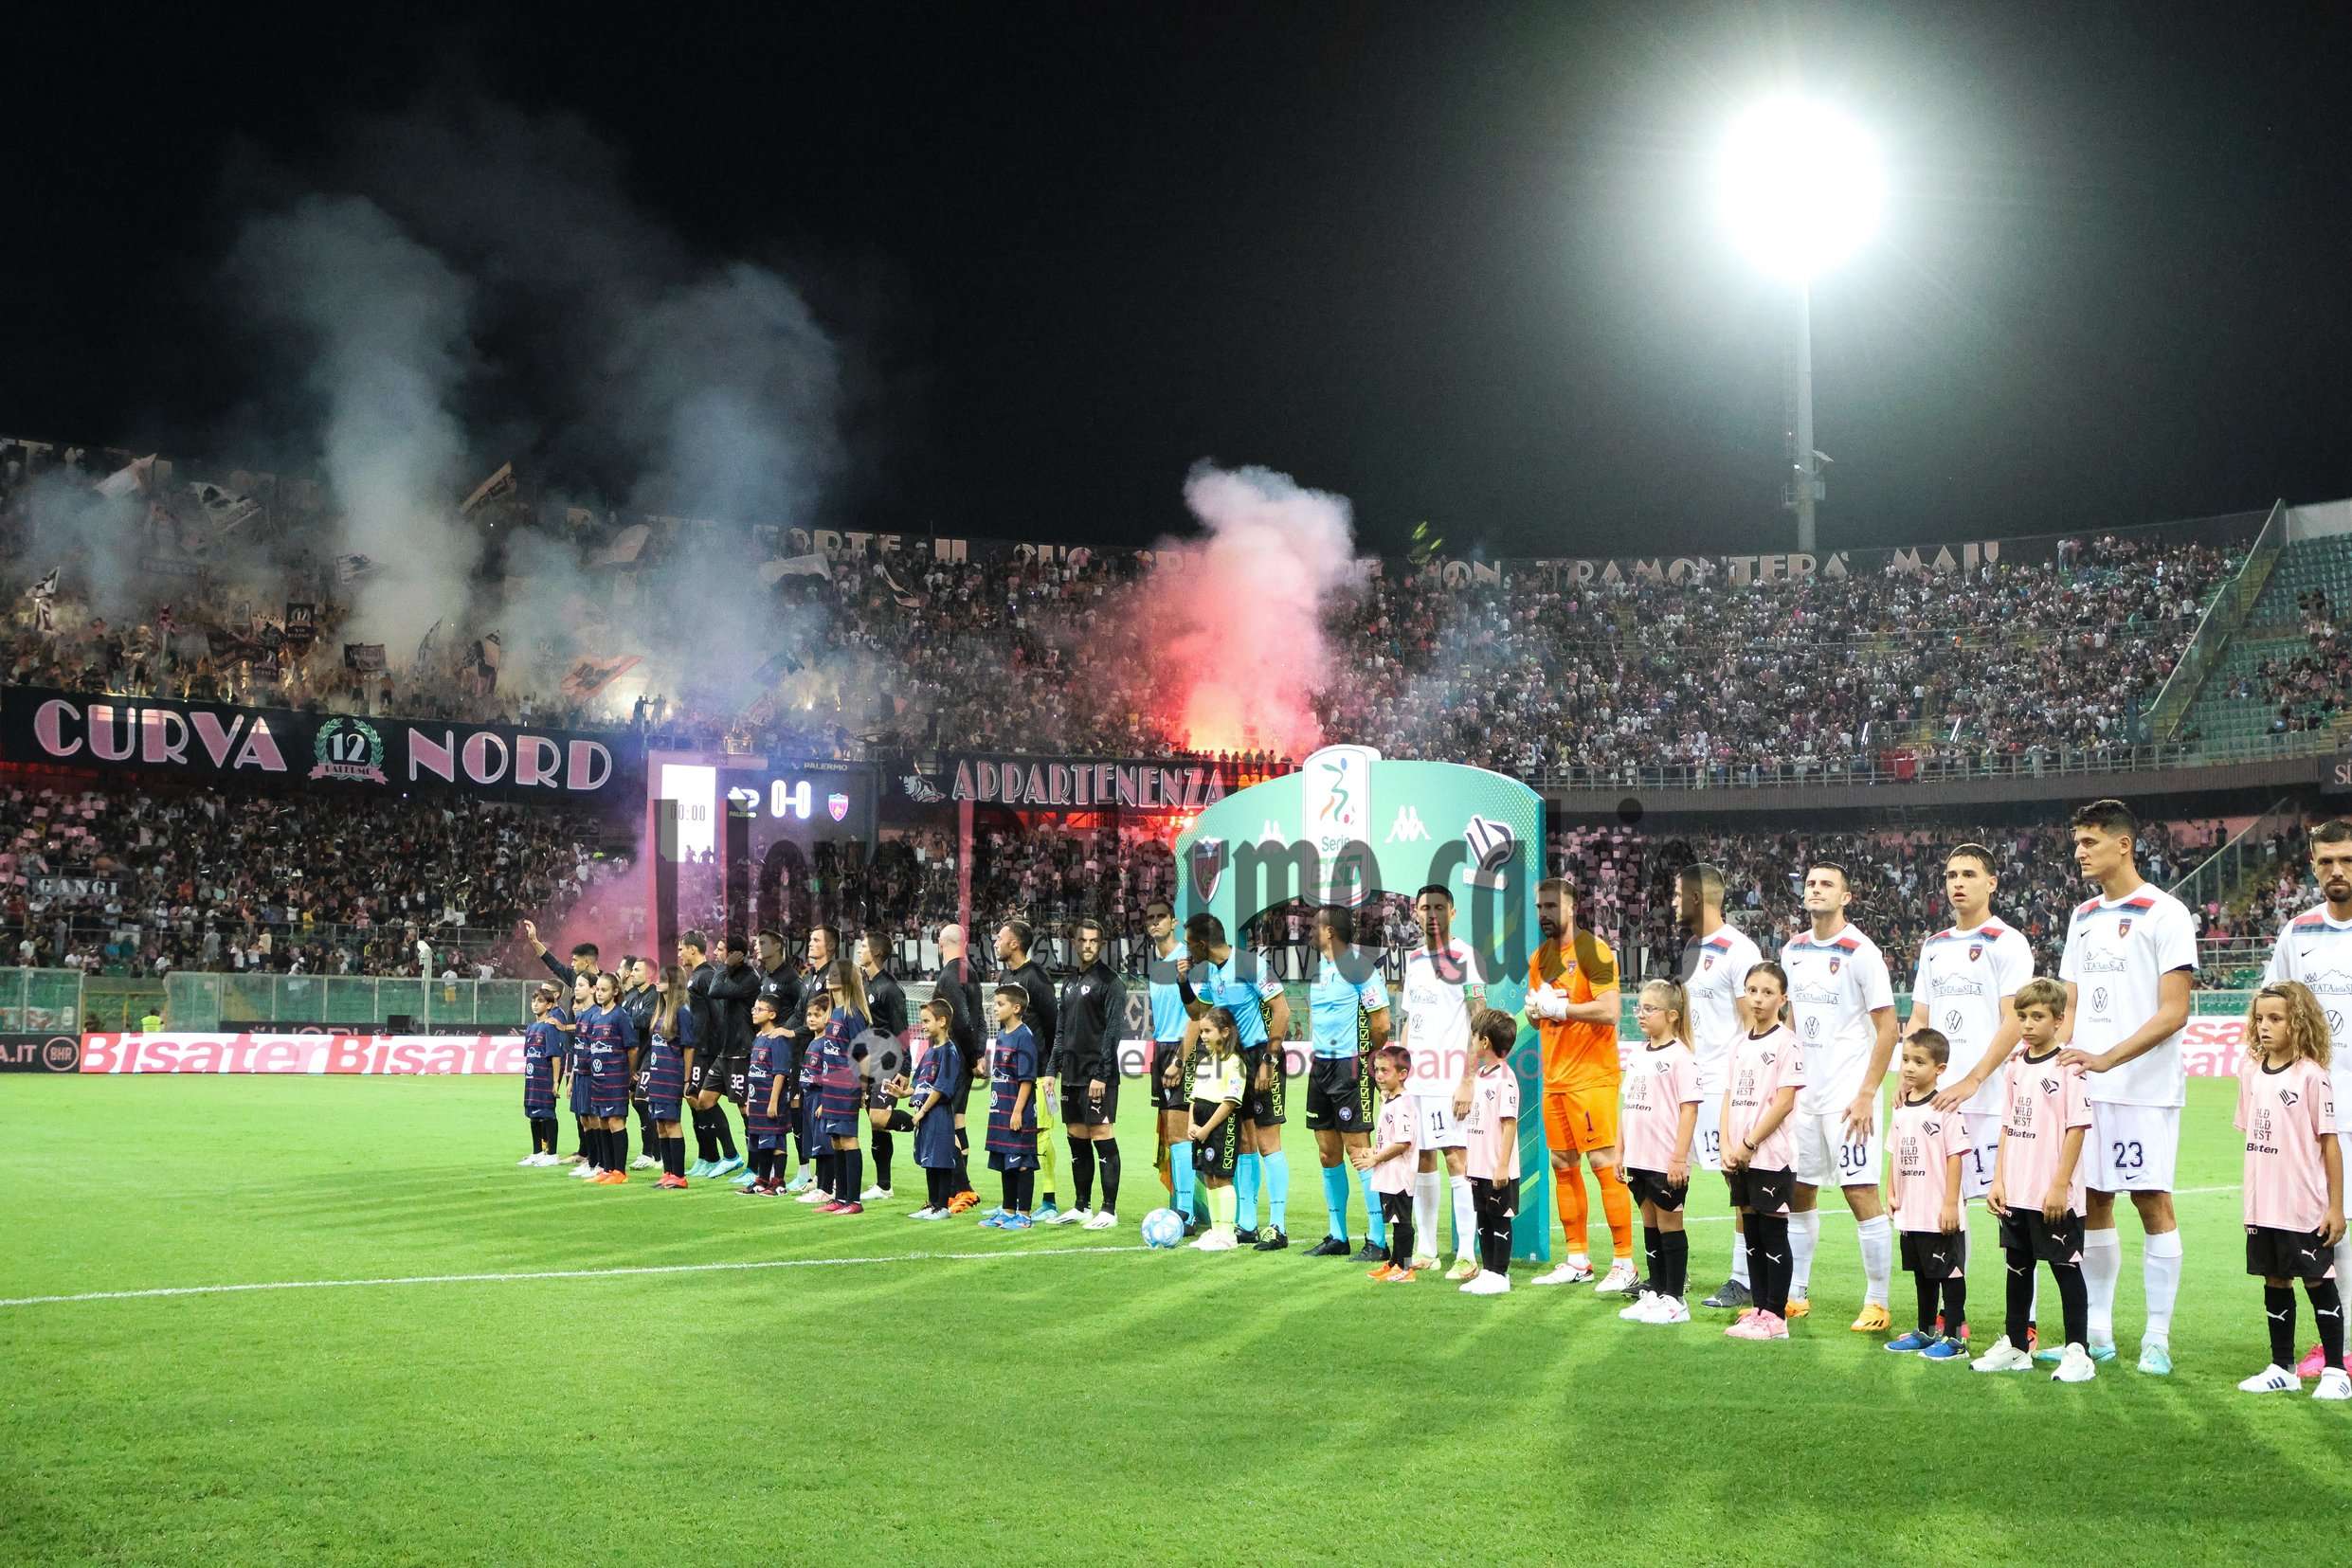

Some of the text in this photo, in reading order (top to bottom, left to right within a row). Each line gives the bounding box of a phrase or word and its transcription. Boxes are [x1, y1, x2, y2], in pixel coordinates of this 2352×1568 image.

[34, 699, 612, 790] CURVA NORD
[331, 732, 366, 763] 12
[951, 759, 1225, 809] APPARTENENZA
[1322, 836, 1351, 852] Serie
[641, 1072, 650, 1086] 17
[692, 1066, 701, 1081] 8
[731, 1073, 745, 1090] 32
[1431, 1110, 1445, 1131] 11
[1584, 1110, 1594, 1132] 1
[1705, 1130, 1720, 1152] 13
[1839, 1144, 1867, 1168] 30
[2112, 1141, 2144, 1168] 23
